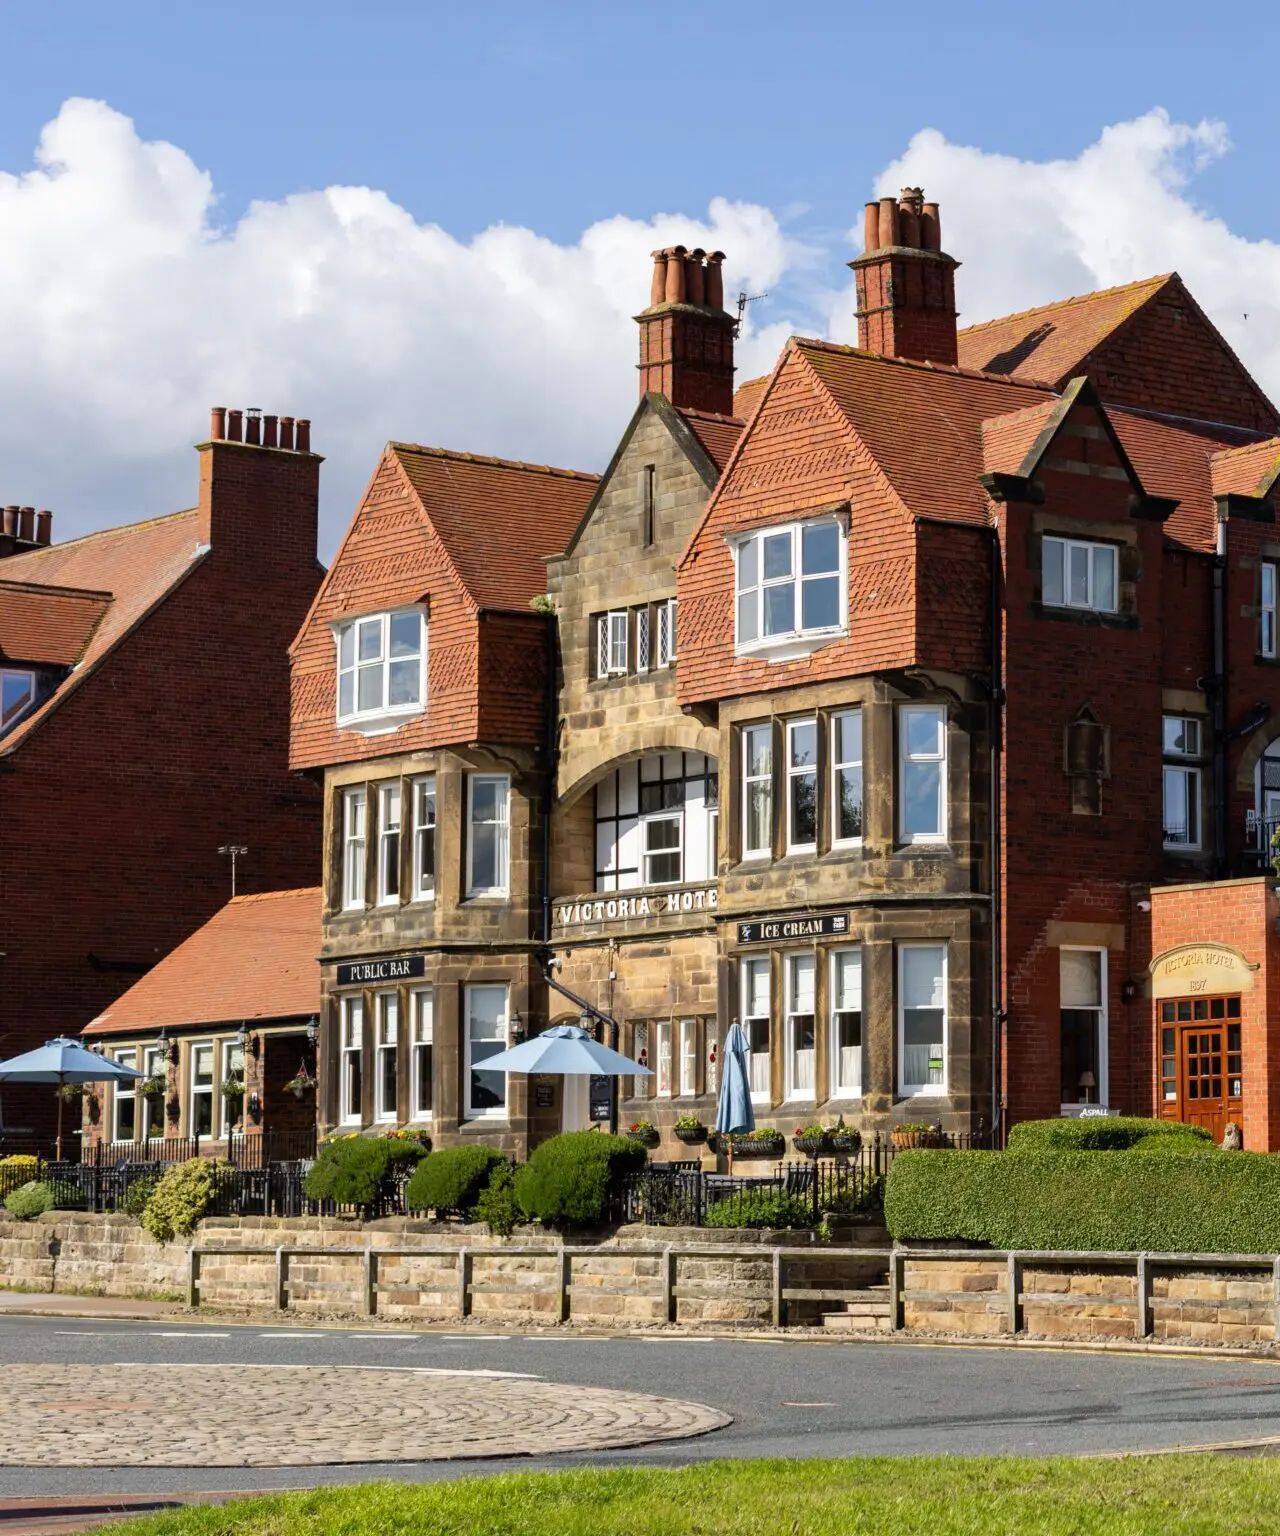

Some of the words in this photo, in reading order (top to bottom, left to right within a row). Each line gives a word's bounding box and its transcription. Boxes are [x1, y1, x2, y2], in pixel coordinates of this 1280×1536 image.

[561, 897, 650, 923] VICTORIA
[760, 923, 780, 938] ICE
[783, 919, 823, 936] CREAM
[351, 963, 388, 980] PUBLIC
[391, 961, 410, 975] BAR
[1164, 952, 1203, 974] VICTORIA
[1206, 953, 1235, 969] HOTEL
[1190, 978, 1208, 992] 1897
[1079, 1108, 1109, 1119] ASPALL
